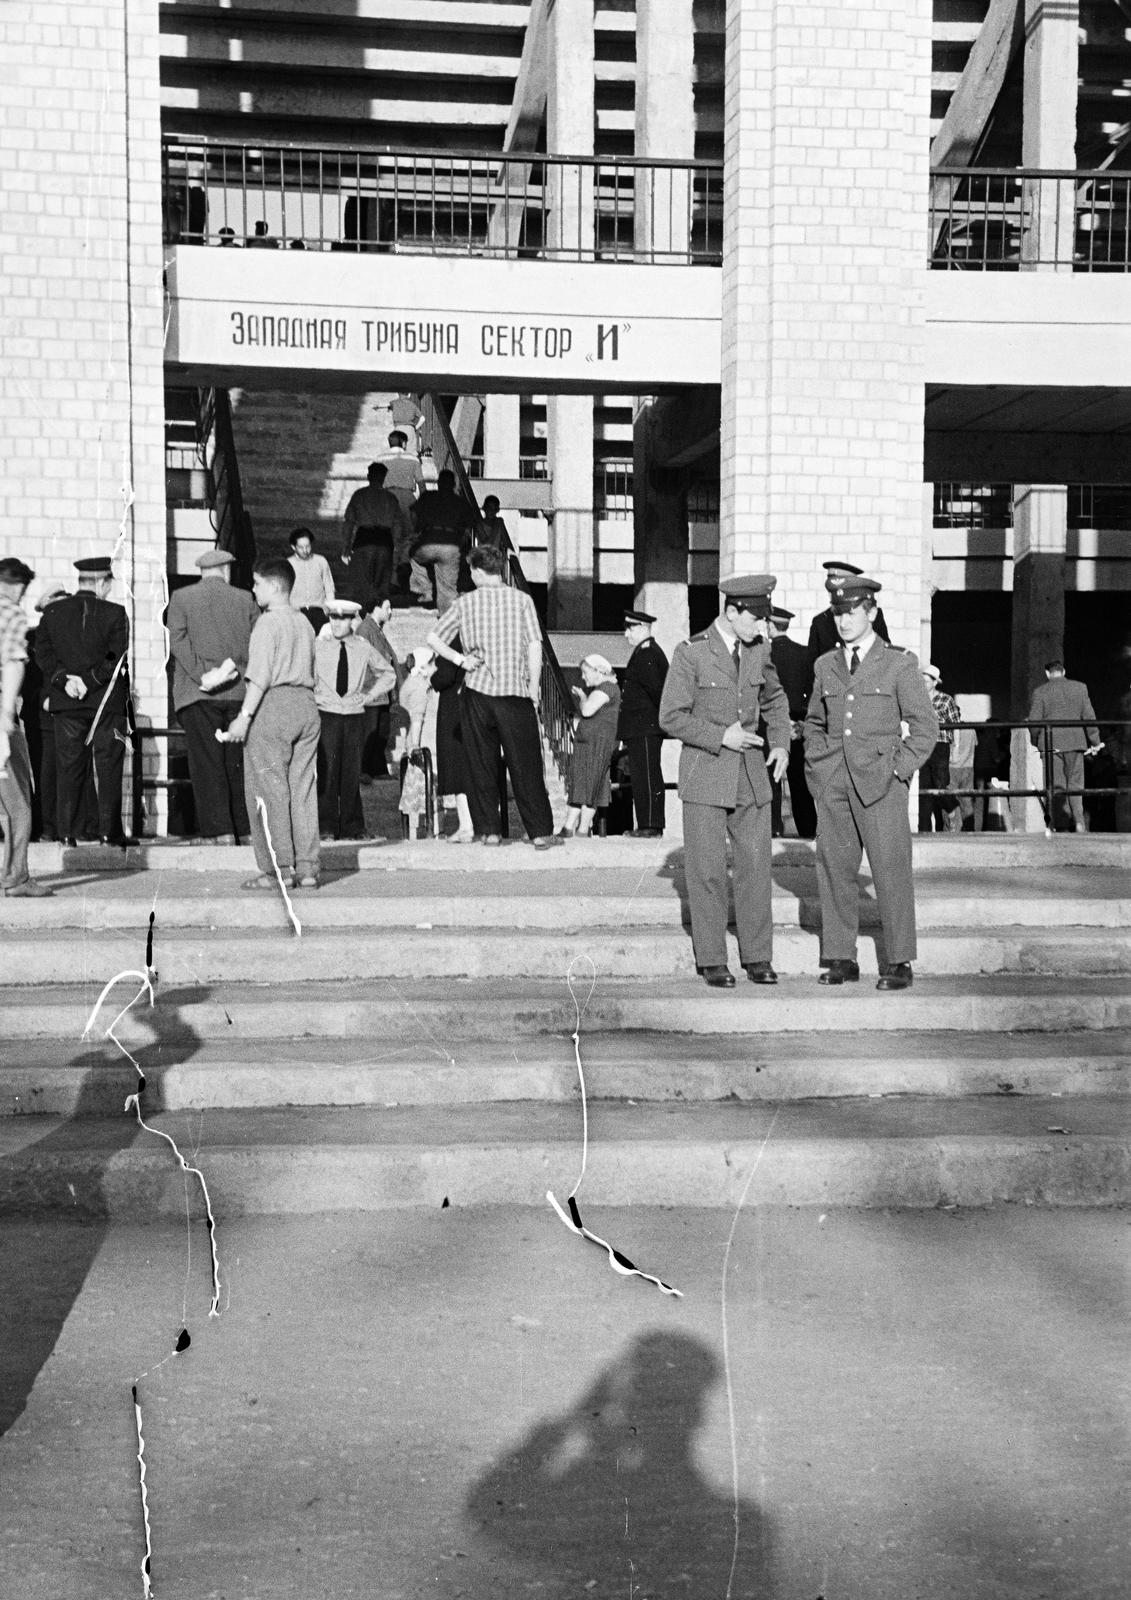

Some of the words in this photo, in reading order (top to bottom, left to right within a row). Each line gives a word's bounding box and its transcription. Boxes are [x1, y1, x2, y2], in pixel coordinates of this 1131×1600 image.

[231, 311, 347, 350] ЗАПАДНАЯ
[361, 320, 459, 354] ТРИБУНА
[481, 324, 572, 359] СЕКТОР
